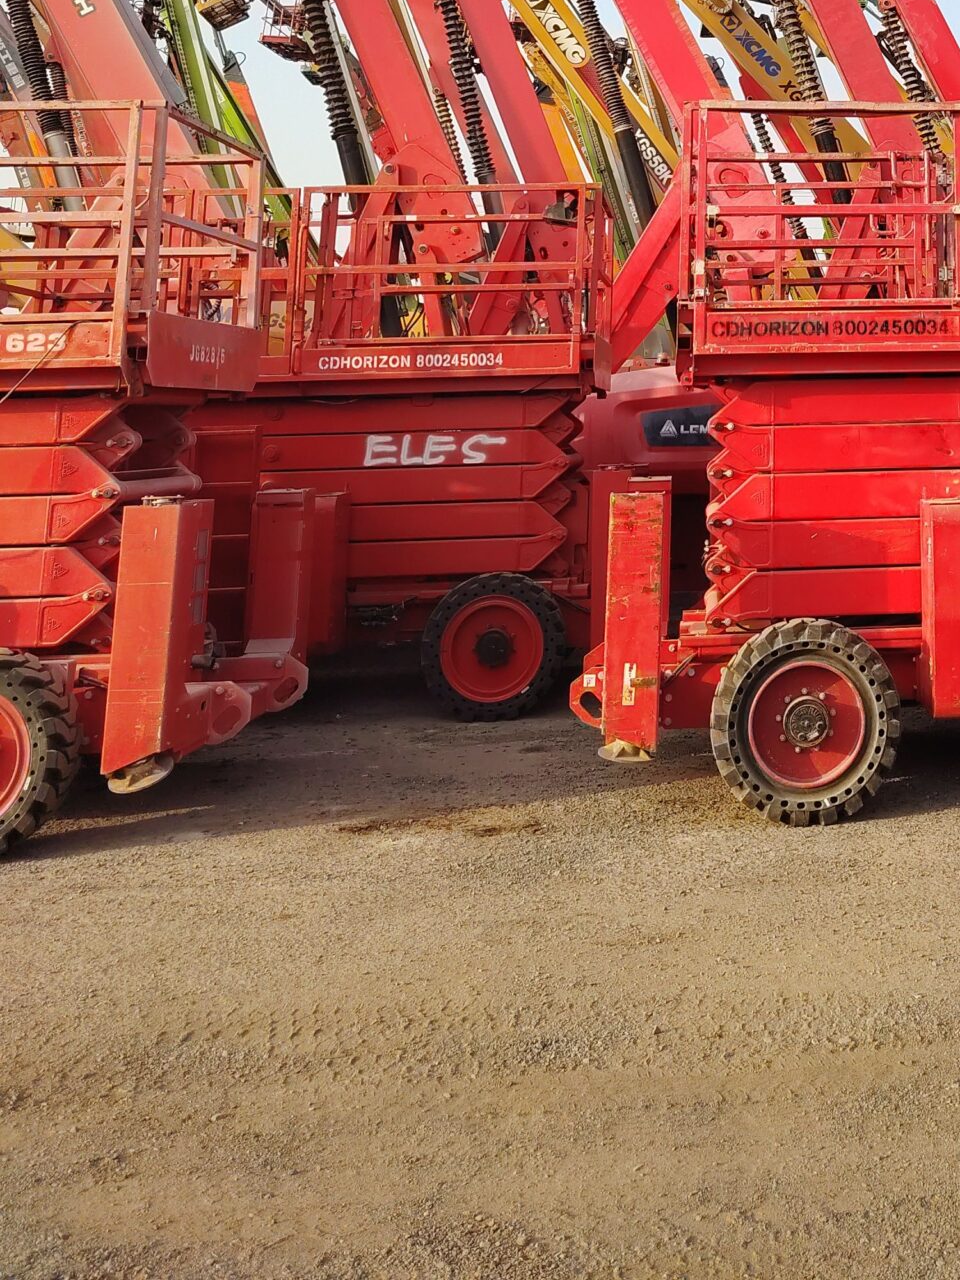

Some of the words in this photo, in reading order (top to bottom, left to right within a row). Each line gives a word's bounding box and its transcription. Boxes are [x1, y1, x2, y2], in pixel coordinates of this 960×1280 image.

[734, 26, 781, 77] XCMG
[778, 79, 806, 101] XG
[711, 319, 829, 338] CDHORIZON
[831, 318, 950, 337] 8002450034
[0, 332, 67, 353] 623
[318, 355, 411, 370] CDHORIZON
[415, 352, 504, 368] 8002450034
